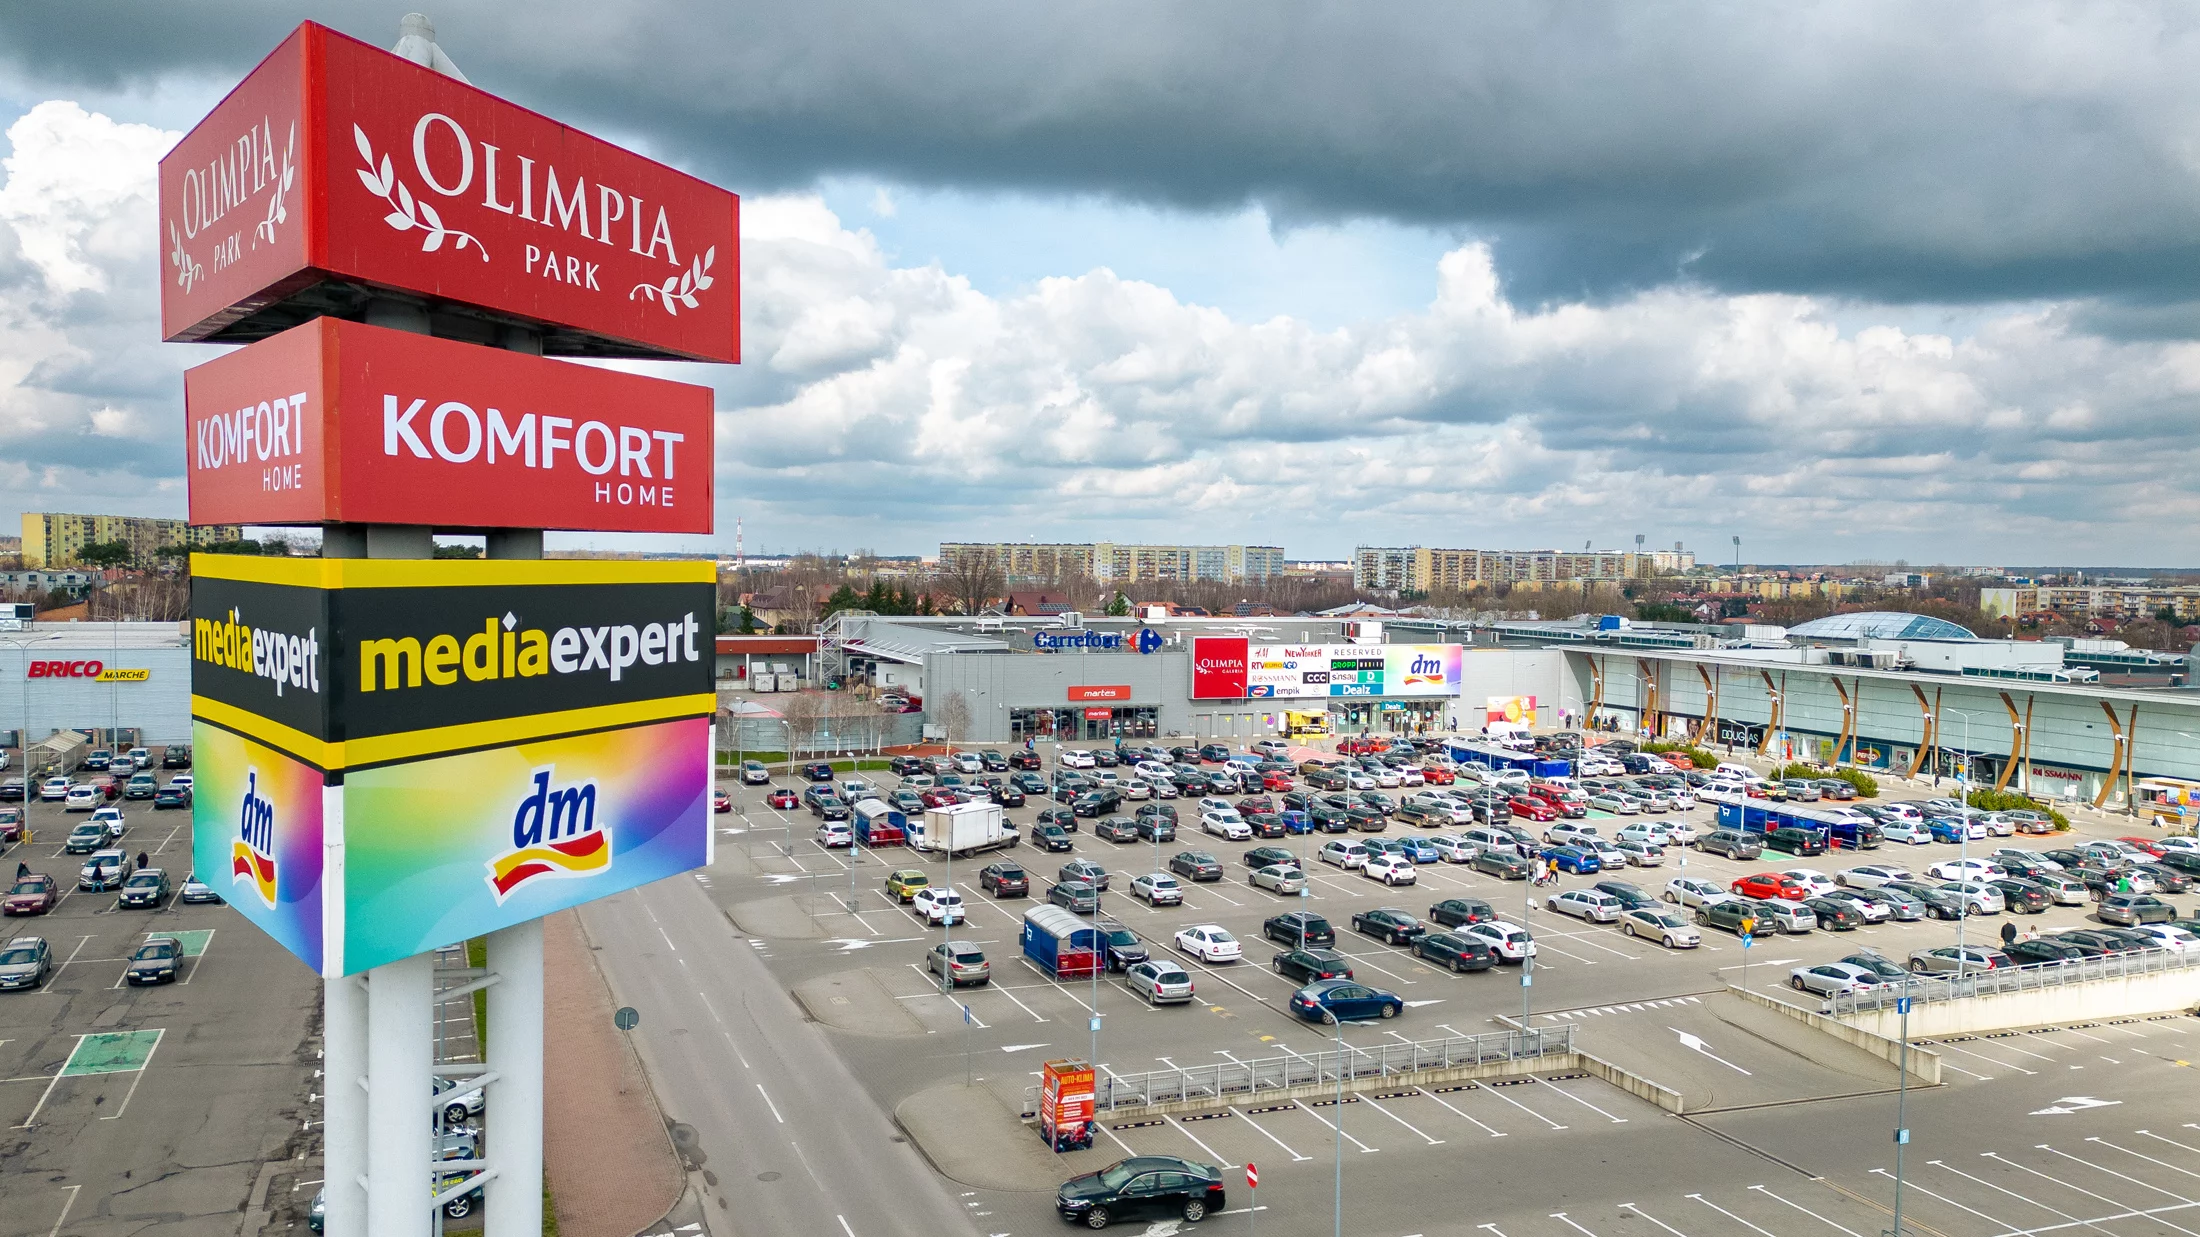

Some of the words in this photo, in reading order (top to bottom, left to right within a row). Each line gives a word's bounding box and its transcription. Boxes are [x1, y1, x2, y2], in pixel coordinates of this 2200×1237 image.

[182, 114, 277, 241] OLIMPIA
[412, 112, 681, 267] OLIMPIA
[213, 230, 242, 275] PARK
[526, 244, 601, 292] PARK
[197, 392, 307, 470] KOMFORT
[383, 394, 685, 481] KOMFORT
[262, 464, 302, 492] HOME
[595, 482, 674, 508] HOME
[1034, 631, 1122, 648] Carrefour
[195, 606, 319, 697] mediaexpert
[360, 610, 700, 693] mediaexpert
[1201, 658, 1243, 668] OLIMPIA
[28, 660, 103, 678] BRICO
[104, 669, 146, 680] MARCHÉ
[1332, 661, 1357, 669] CROPP
[1411, 654, 1441, 674] dm
[1306, 673, 1326, 682] CCC
[1332, 672, 1357, 682] sinsay
[1084, 689, 1116, 697] martes
[1276, 686, 1300, 695] empik
[1342, 684, 1371, 695] Dealz
[1721, 729, 1759, 744] DOUGAS
[241, 772, 273, 856] dm
[513, 771, 597, 850] dm
